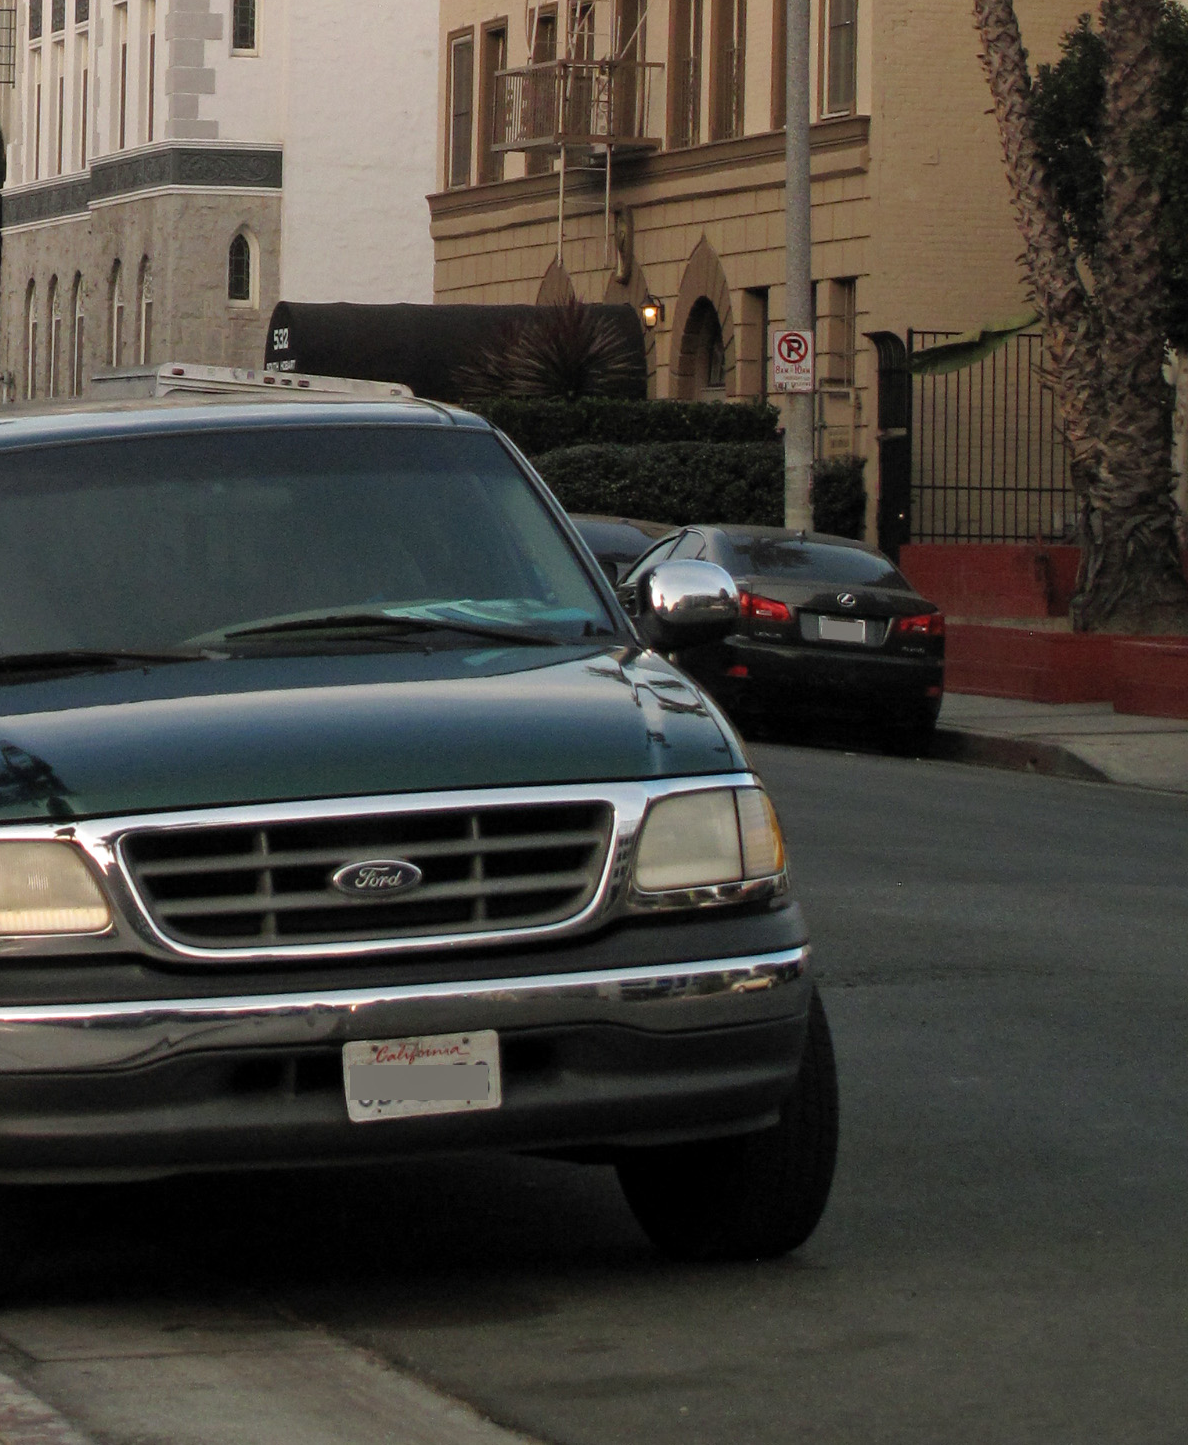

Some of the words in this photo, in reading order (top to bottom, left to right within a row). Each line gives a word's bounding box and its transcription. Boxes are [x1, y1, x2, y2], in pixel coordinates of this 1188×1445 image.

[273, 328, 289, 350] 532
[354, 866, 403, 889] Ford
[375, 1043, 470, 1065] California
